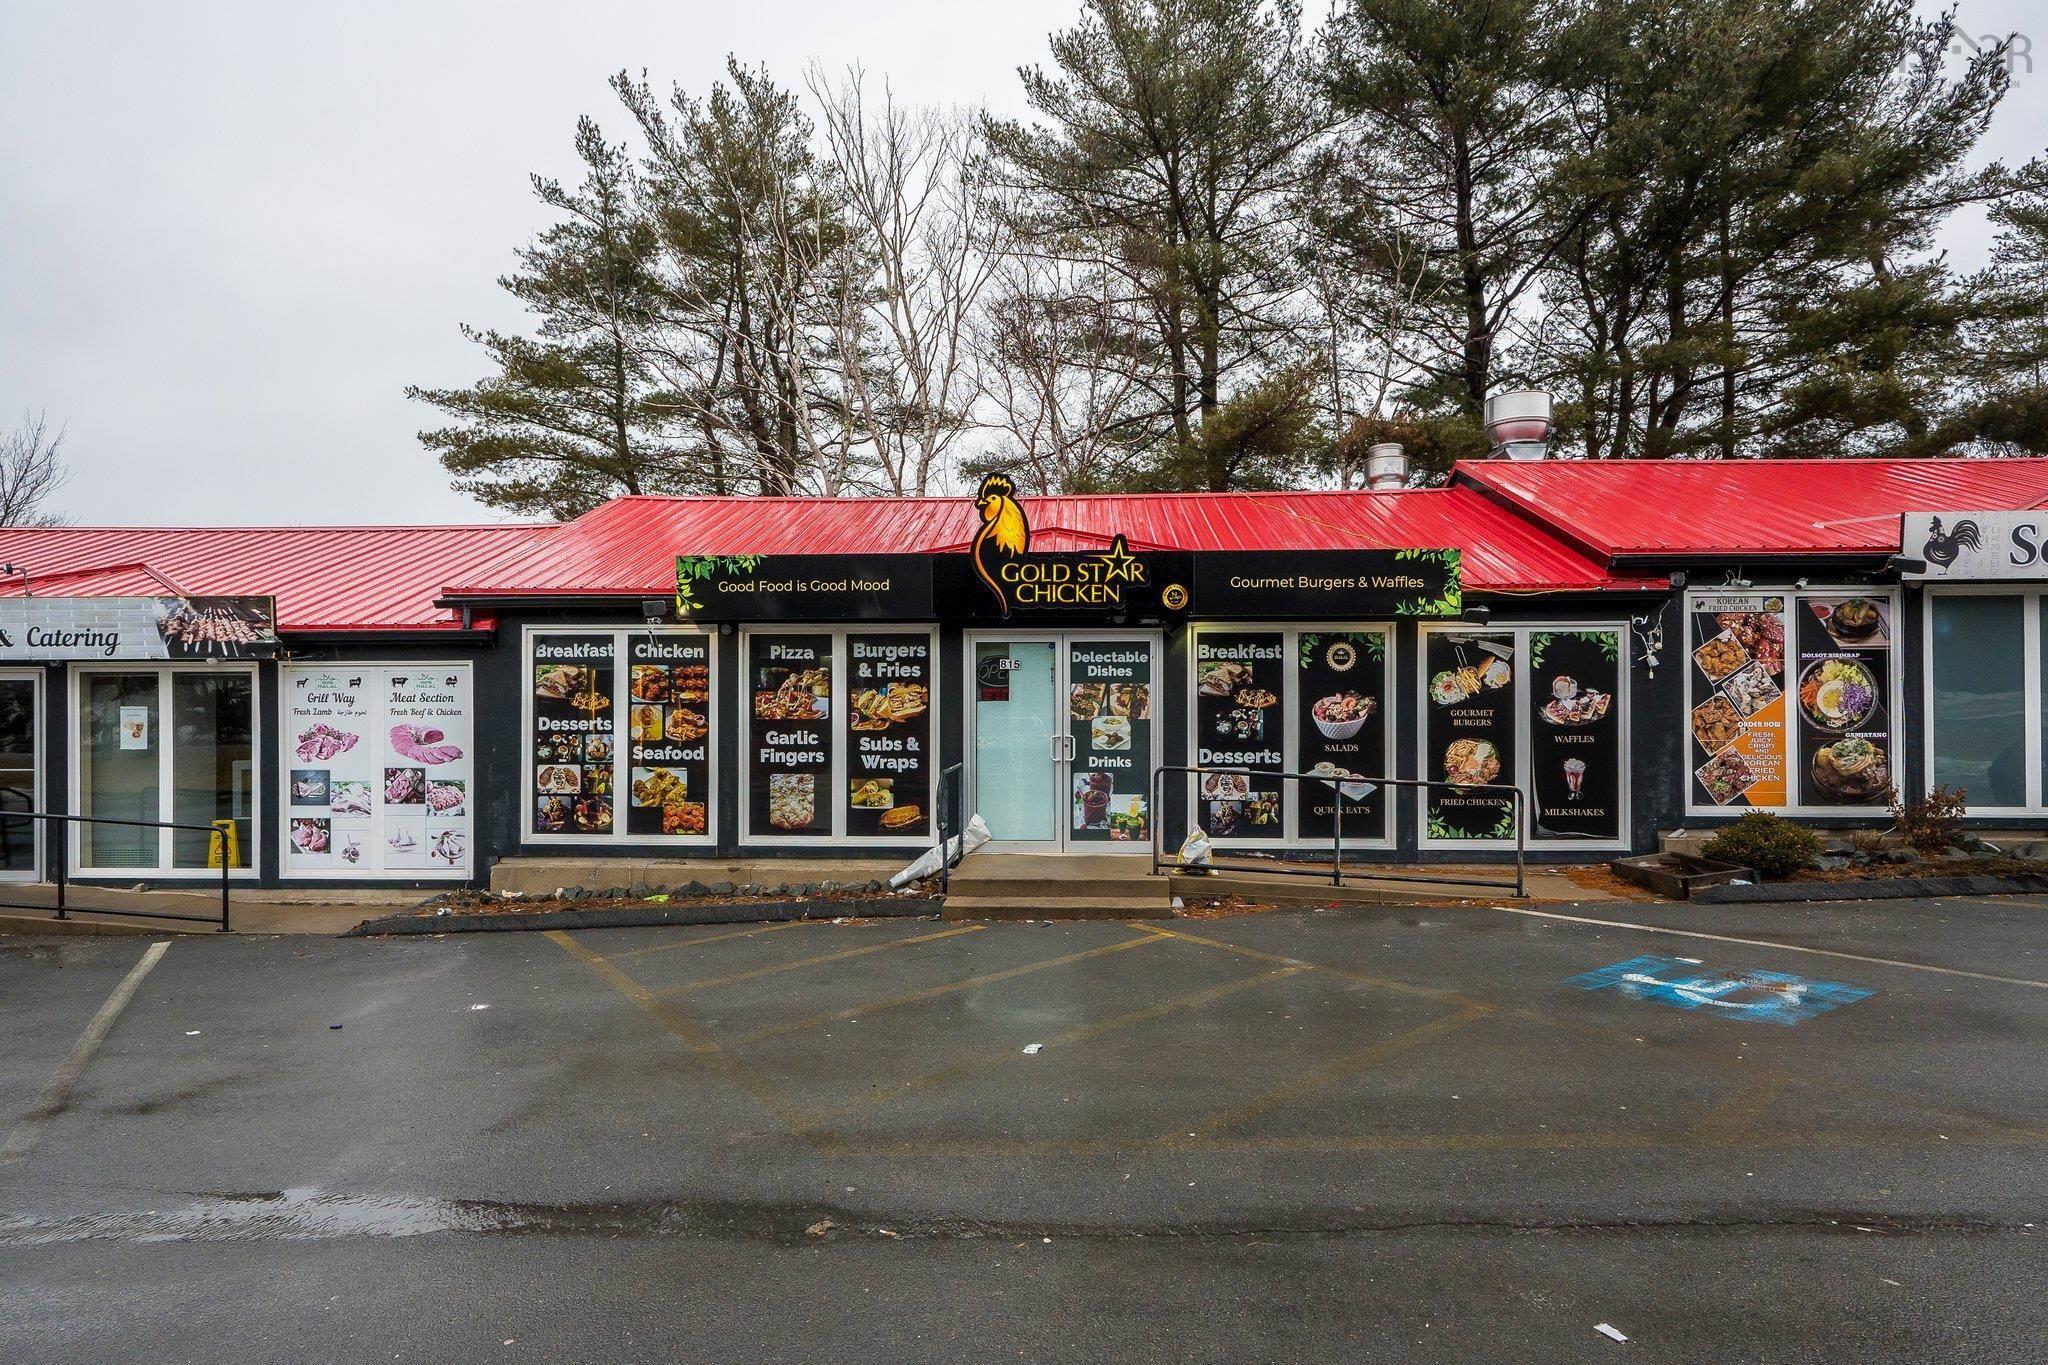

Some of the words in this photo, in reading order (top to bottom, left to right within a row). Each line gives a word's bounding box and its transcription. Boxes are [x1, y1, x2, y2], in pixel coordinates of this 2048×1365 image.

[2009, 524, 2048, 565] S
[1001, 563, 1070, 582] GOLD
[718, 581, 754, 592] Good
[759, 580, 793, 592] Food
[797, 580, 807, 591] is
[810, 580, 847, 591] Good
[851, 579, 890, 591] Mood
[1230, 576, 1294, 588] Gourmet
[1298, 576, 1355, 590] Burgers
[1358, 576, 1368, 588] &
[1371, 575, 1424, 588] Waffles
[1016, 584, 1120, 602] CHICKEN
[27, 627, 121, 656] Catering
[536, 643, 614, 658] Breakfast
[635, 643, 704, 658] Chicken
[770, 645, 814, 659] Pizza
[853, 643, 927, 661] Burgers
[1072, 651, 1148, 663] Delectable
[1198, 644, 1282, 659] Breakfast
[858, 662, 872, 677] &
[877, 662, 922, 677] Fries
[978, 664, 1009, 679] OPE
[1000, 660, 1020, 669] 815
[1088, 665, 1133, 676] Dishes
[307, 693, 329, 703] Grill
[332, 693, 355, 707] Way
[390, 692, 416, 702] Meat
[419, 692, 454, 702] Section
[410, 708, 426, 718] Beef
[538, 716, 613, 731] Desserts
[765, 730, 819, 745] Garlic
[859, 737, 903, 751] Subs
[906, 737, 920, 751] &
[1554, 735, 1595, 743] WAFFLES
[632, 746, 705, 761] Seafood
[760, 748, 825, 766] Fingers
[1199, 749, 1282, 763] Desserts
[861, 754, 918, 772] Wraps
[1088, 756, 1132, 767] Drinks
[1544, 808, 1605, 816] MILKSHAKES
